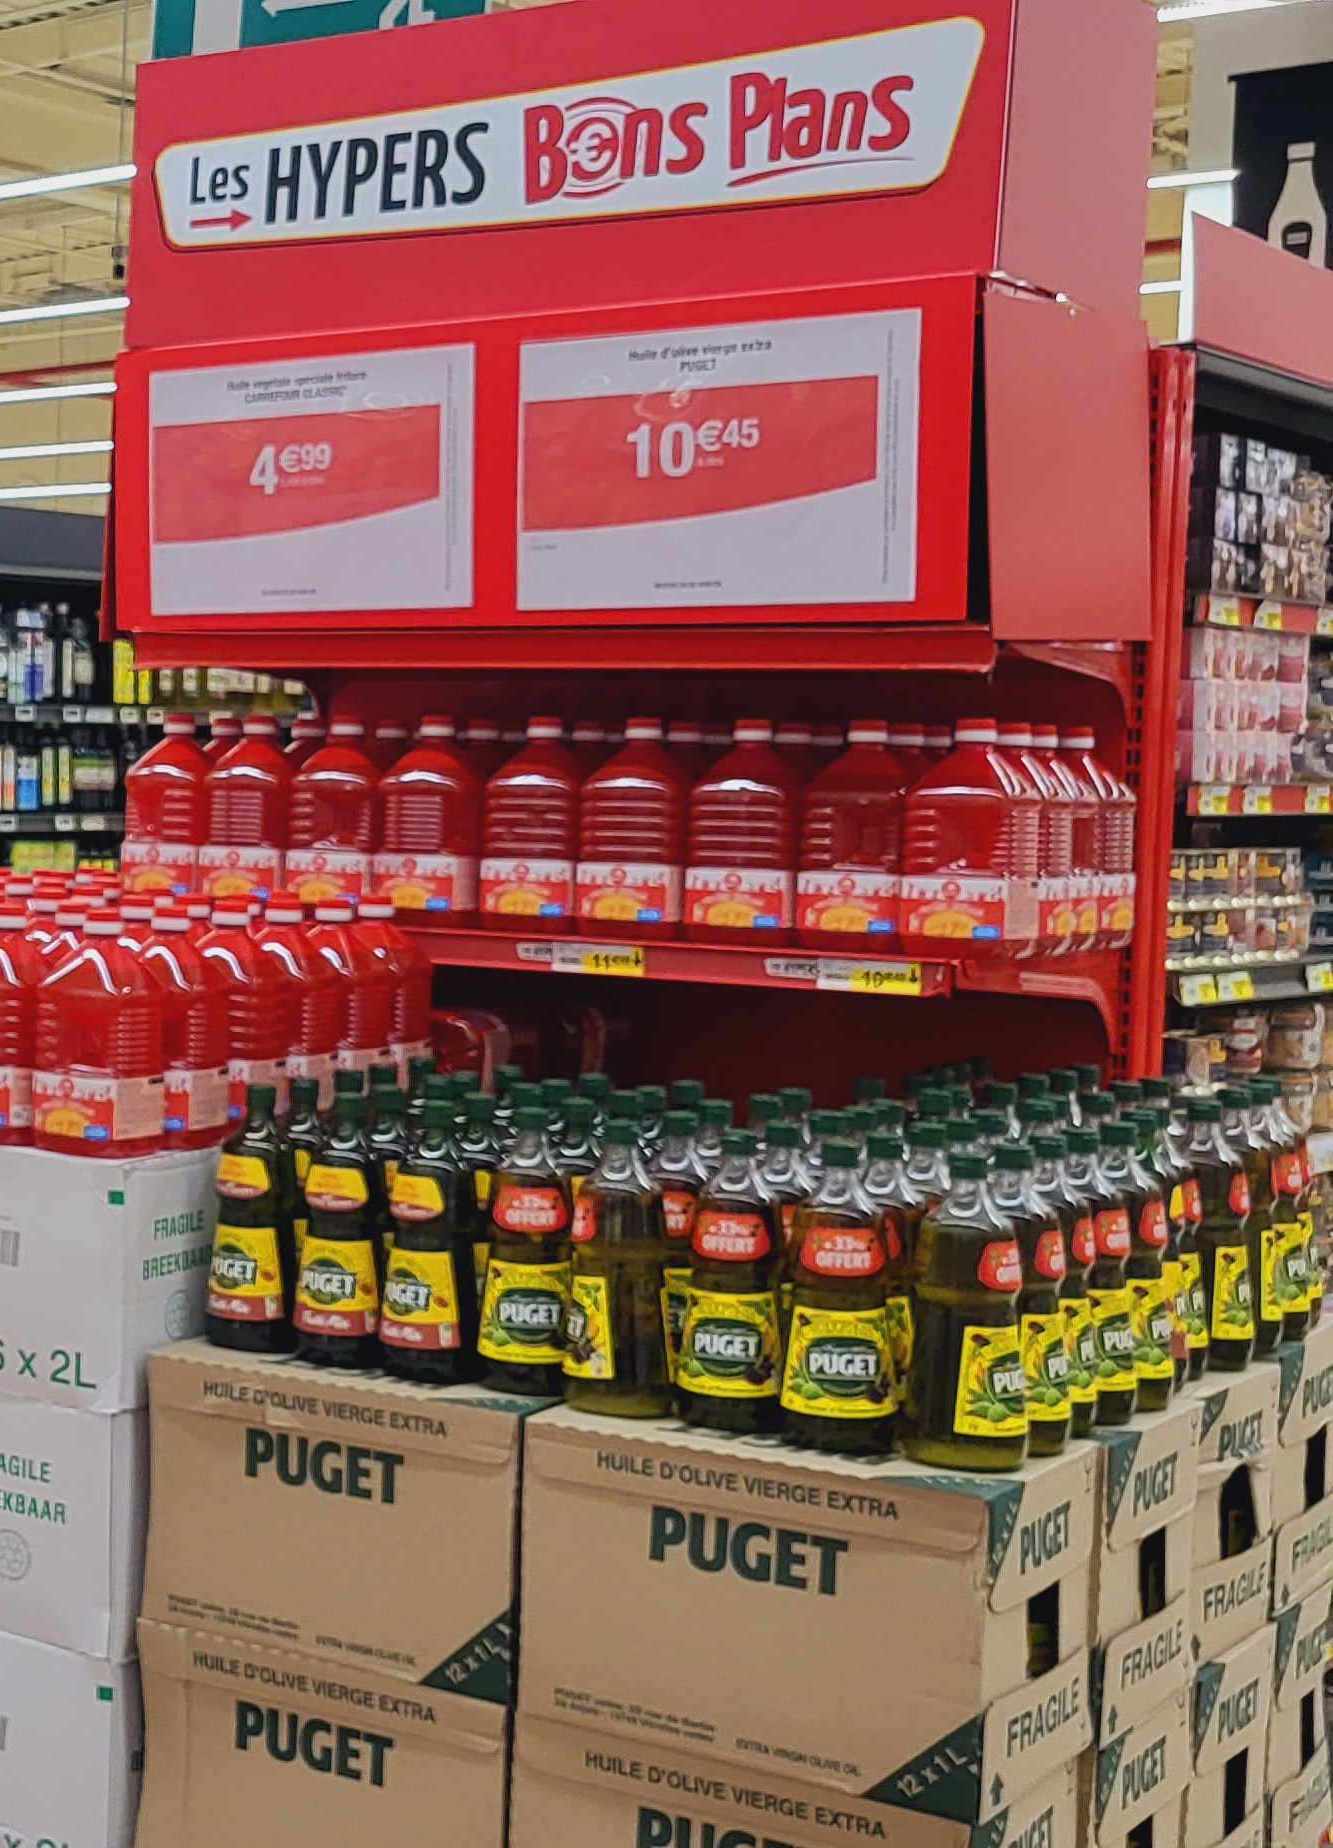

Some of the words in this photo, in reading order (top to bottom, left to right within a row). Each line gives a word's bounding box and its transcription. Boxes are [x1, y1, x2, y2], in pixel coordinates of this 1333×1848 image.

[190, 154, 250, 203] Les
[265, 122, 490, 224] HYPERS
[730, 72, 914, 171] Plans
[154, 1209, 203, 1241] FRAGILE
[498, 1302, 560, 1326] PUGET
[694, 1333, 758, 1357] PUGET
[18, 1349, 36, 1377] x
[50, 1349, 97, 1390] 2L
[809, 1352, 877, 1376] PUGET
[203, 1380, 249, 1405] HUILE
[254, 1388, 319, 1416] D'OLIVE
[323, 1401, 386, 1428] VIERGE
[389, 1412, 448, 1438] EXTRA
[244, 1426, 405, 1505] PUGET
[596, 1450, 653, 1477] HUILE
[659, 1460, 737, 1493] D'OLIVE
[742, 1478, 822, 1508] VIERGE
[827, 1490, 899, 1521] EXTRA
[1132, 1451, 1178, 1517] PUGET
[648, 1503, 849, 1596] PUGET
[1019, 1500, 1071, 1576] PUGET
[1203, 1561, 1267, 1623] FRAGILE
[192, 1651, 241, 1680] HUILE
[243, 1662, 308, 1692] D'OLIVE
[311, 1677, 375, 1710] VIERGE
[378, 1692, 437, 1724] EXTRA
[1121, 1618, 1184, 1691] FRAGILE
[234, 1698, 395, 1788] PUGET
[1006, 1676, 1080, 1759] FRAGILE
[1218, 1678, 1259, 1744] PUGET
[585, 1751, 642, 1779] HUILE
[647, 1765, 726, 1799] D'OLIVE
[731, 1785, 808, 1820] VIERGE
[815, 1805, 886, 1839] EXTRA
[897, 1773, 924, 1799] 12
[1122, 1735, 1167, 1811] PUGET
